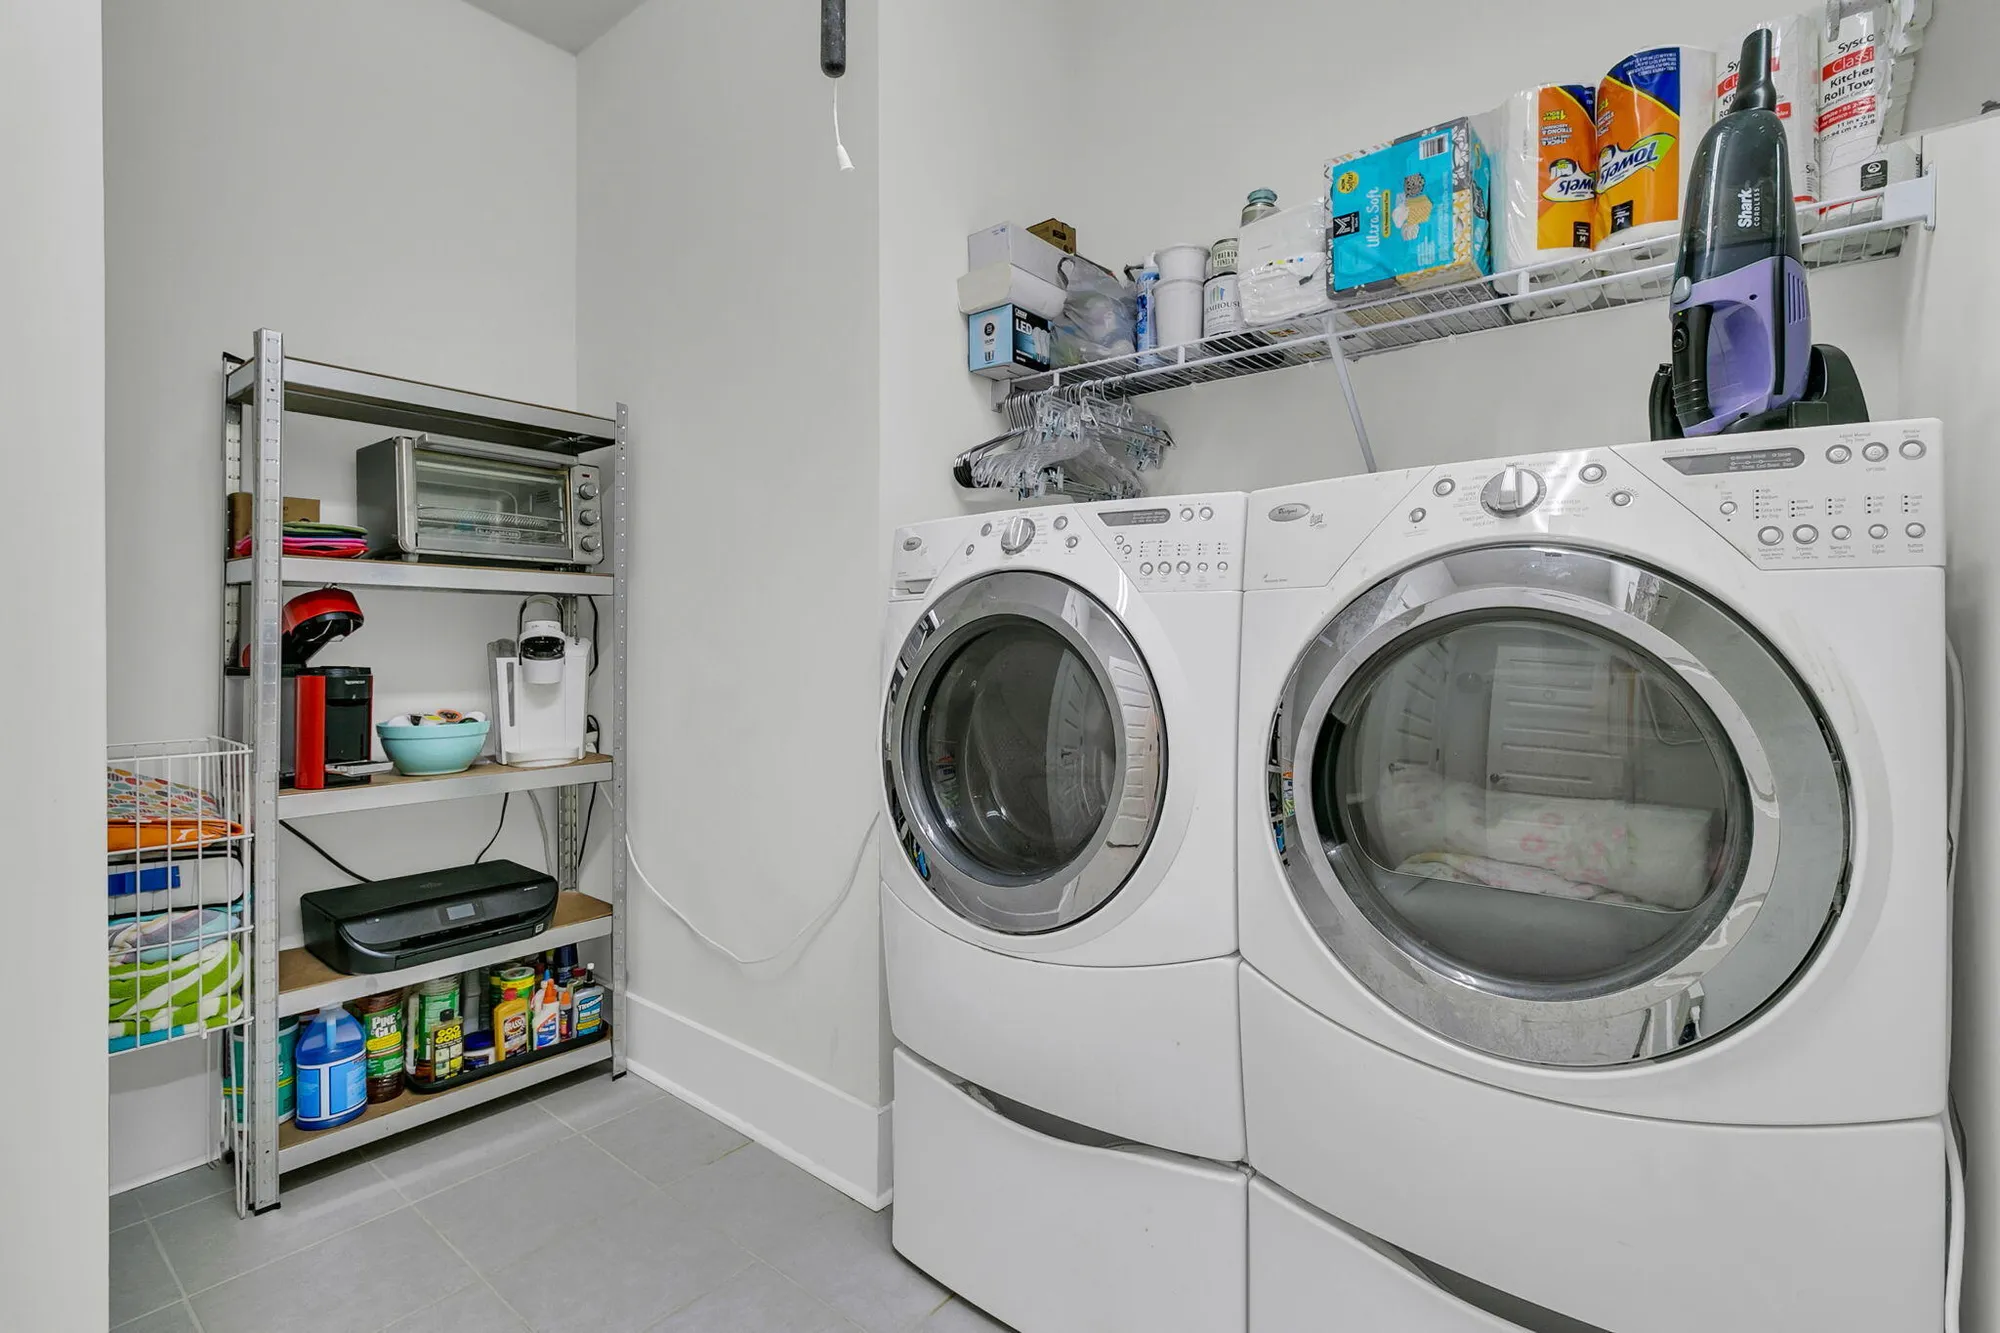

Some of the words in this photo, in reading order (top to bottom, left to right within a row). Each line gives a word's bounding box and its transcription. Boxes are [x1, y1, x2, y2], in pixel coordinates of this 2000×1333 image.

[1824, 86, 1845, 103] Roll
[1601, 140, 1658, 184] Towels
[1366, 186, 1382, 214] Soft
[1738, 187, 1753, 228] Shark
[1366, 214, 1380, 248] Ultra
[1016, 318, 1032, 336] LED
[372, 1013, 396, 1030] PINE
[376, 1024, 396, 1038] GLO
[436, 1031, 462, 1044] GONE
[438, 1025, 460, 1037] GOO
